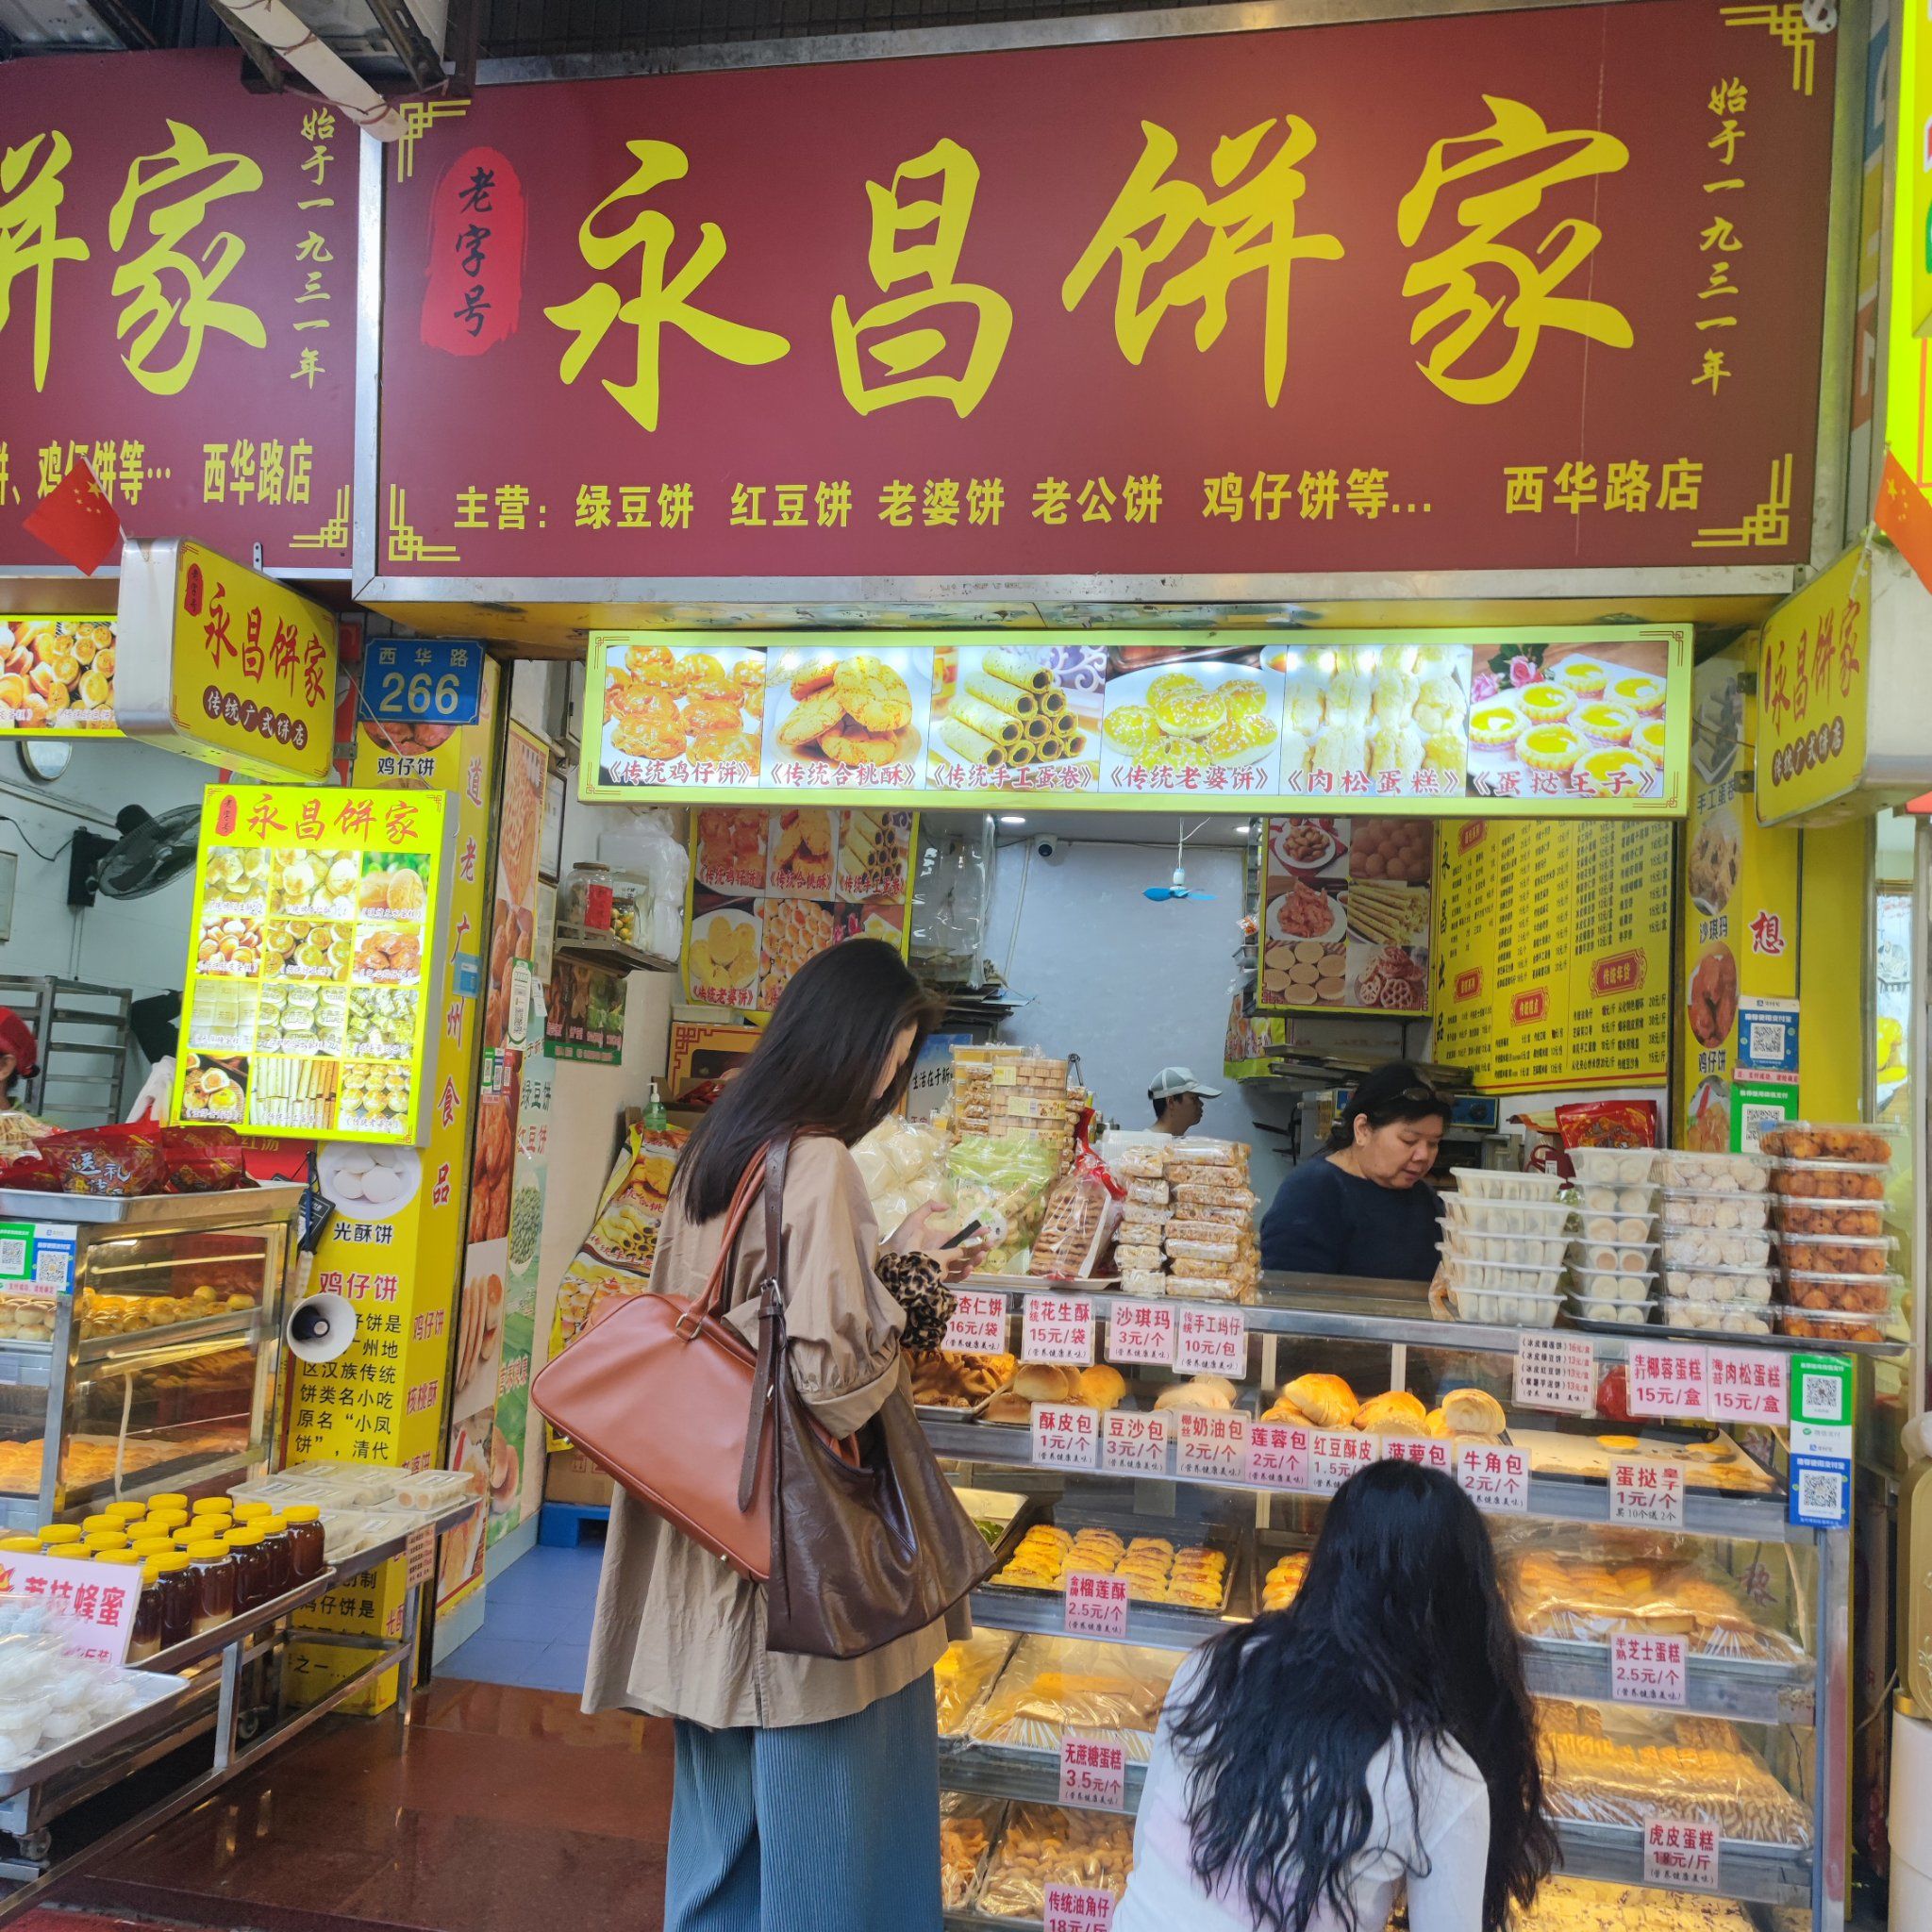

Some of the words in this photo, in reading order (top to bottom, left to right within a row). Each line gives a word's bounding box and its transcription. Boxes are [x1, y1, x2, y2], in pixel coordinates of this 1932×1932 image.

[1691, 76, 1746, 396] 始于一九三一年
[291, 108, 336, 390] 始于一九三一年
[454, 166, 496, 337] 老字号
[543, 92, 1635, 433] 永昌饼家
[203, 438, 313, 506] 西华路店
[575, 483, 694, 529] 绿豆饼
[729, 479, 853, 528] 红豆饼
[877, 476, 1006, 526] 老婆饼
[1030, 474, 1163, 525] 老公饼
[1504, 458, 1704, 513] 西华路店
[203, 582, 327, 708] 永昌饼家
[379, 647, 469, 667] 西华路
[1772, 598, 1860, 737] 永昌饼家
[379, 672, 460, 714] 266
[207, 691, 305, 746] 传统广式饼店
[377, 756, 435, 776] 鸡仔饼
[606, 758, 751, 785] 《传统鸡仔饼》
[1109, 765, 1269, 791] 《传统老婆饼》
[1288, 768, 1459, 796] 《肉松蛋糕》
[1473, 769, 1655, 797] 《蛋挞王子》
[246, 793, 420, 845] 永昌饼家
[1750, 909, 1785, 956] 想
[1698, 1050, 1726, 1074] 鸡仔饼
[332, 1222, 393, 1245] 光酥饼
[319, 1272, 399, 1302] 鸡仔饼
[954, 1296, 1003, 1317] 杏仁饼
[1116, 1306, 1171, 1330] 沙琪玛
[412, 1308, 445, 1341] 鸡仔饼
[949, 1321, 998, 1337] 16元/袋
[1029, 1327, 1086, 1345] 15元/袋
[1118, 1332, 1165, 1347] 3元/个
[1185, 1341, 1236, 1357] 10元/包
[303, 1361, 396, 1384] 区汉族传统
[300, 1384, 393, 1410] 饼类名小吃
[1637, 1386, 1702, 1407] 15元/盒
[1713, 1394, 1781, 1413] 15元/盒
[1039, 1411, 1092, 1435] 酥皮包
[1109, 1417, 1164, 1441] 豆沙包
[1040, 1435, 1091, 1452] 1元/个
[1107, 1441, 1163, 1459] 3元/个
[1250, 1427, 1307, 1451] 莲蓉包
[1313, 1435, 1372, 1461] 红豆酥皮
[1185, 1443, 1236, 1462] 2元/个
[1253, 1453, 1300, 1472] 2元/个
[1463, 1450, 1523, 1475] 牛角包
[1314, 1460, 1365, 1478] 1.5元/
[1464, 1474, 1520, 1494] 2元/个
[1617, 1491, 1677, 1509] 1元/个
[1068, 1602, 1123, 1622] 2.5元/个
[1616, 1667, 1679, 1686] 2.5元/个
[1065, 1743, 1122, 1771] 无蔗糖蛋糕
[1066, 1769, 1122, 1793] 3.5元/个
[1649, 1824, 1714, 1852] 虎皮蛋糕
[1049, 1890, 1109, 1919] 传统油角仔
